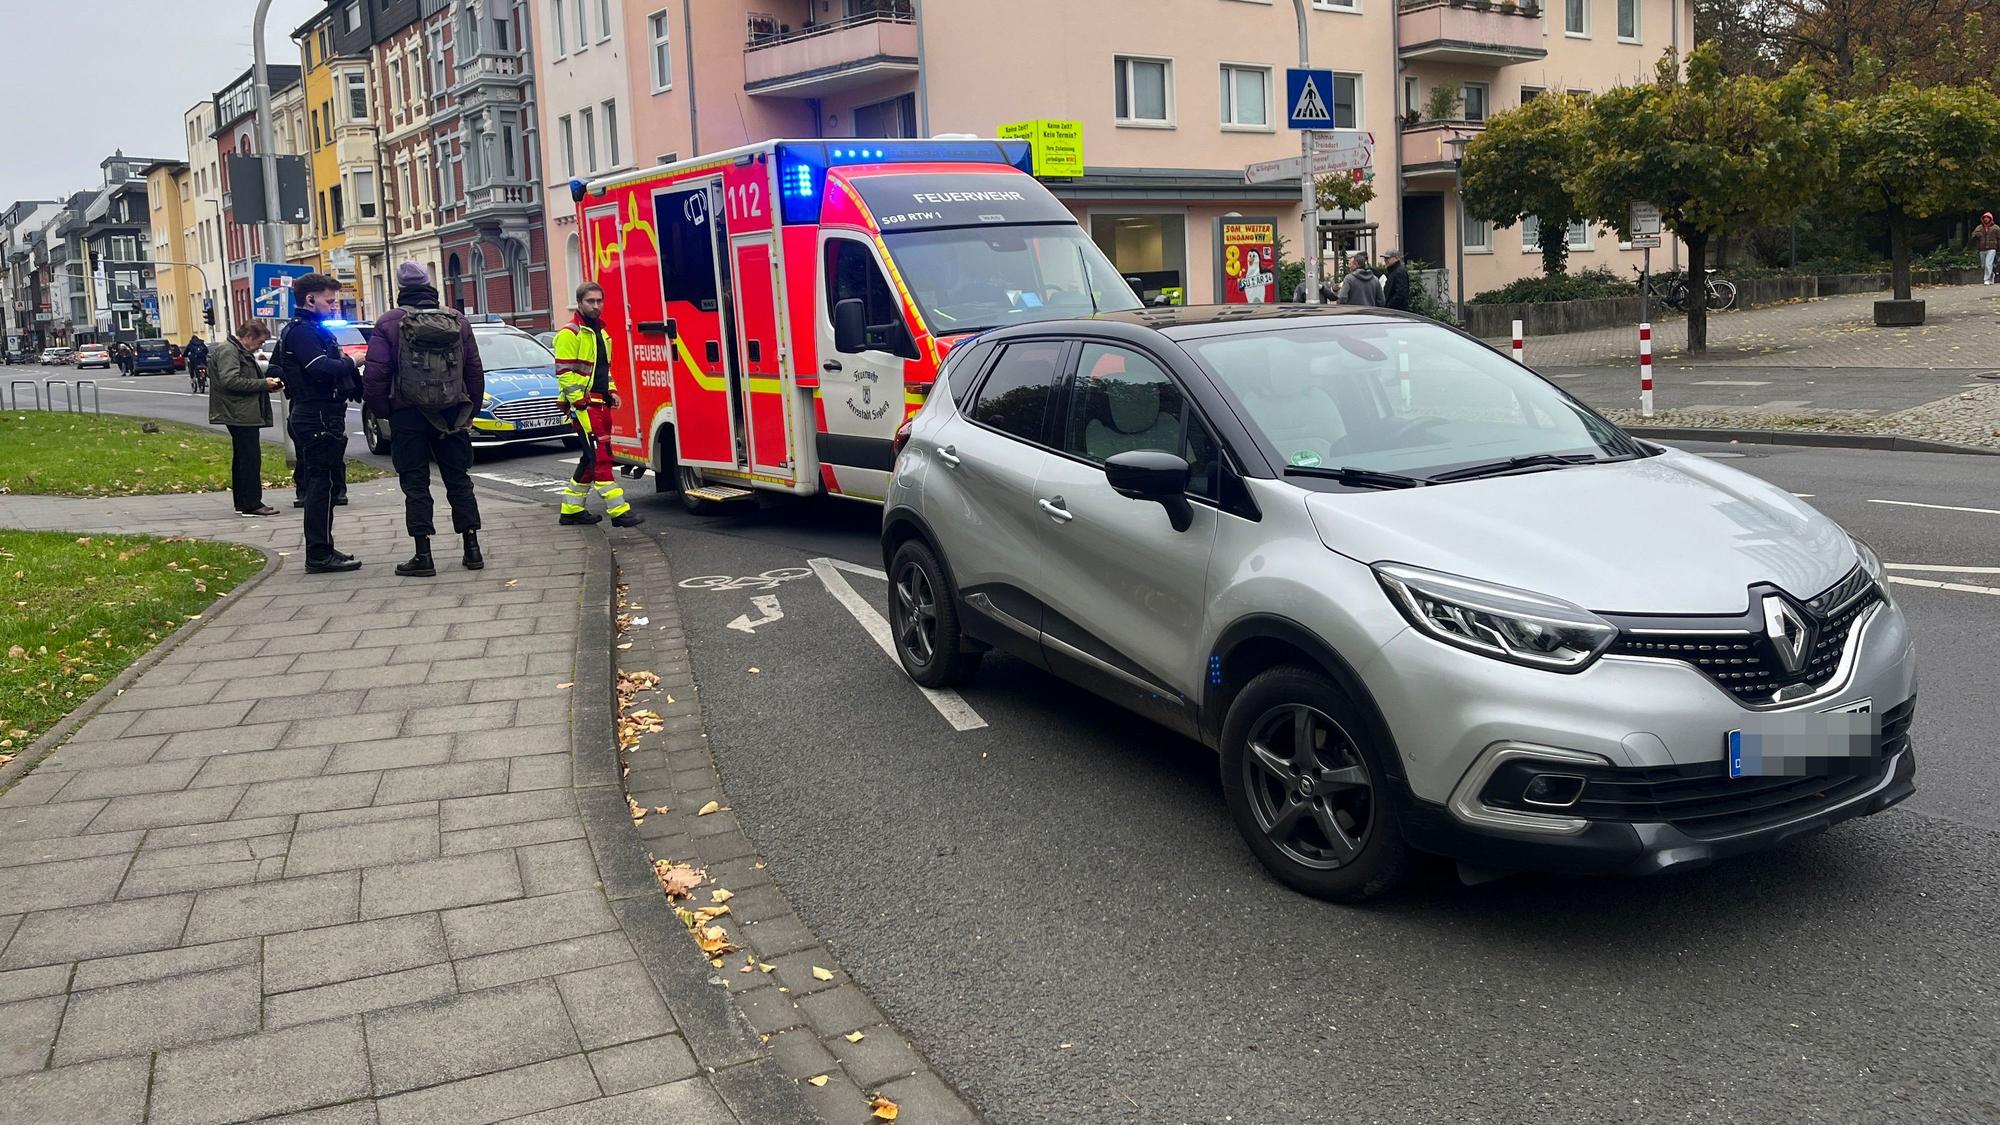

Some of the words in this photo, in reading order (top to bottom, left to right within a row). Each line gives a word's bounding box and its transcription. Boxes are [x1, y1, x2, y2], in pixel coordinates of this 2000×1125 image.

[1056, 131, 1077, 139] Termin?
[728, 182, 762, 220] 112
[913, 190, 1025, 204] FEUERWEHR
[881, 214, 907, 225] SGB
[907, 211, 934, 222] RTW
[934, 211, 942, 219] 1
[634, 344, 668, 362] FEUERW
[488, 373, 552, 383] POLIZEI
[641, 369, 672, 388] SIEGBU
